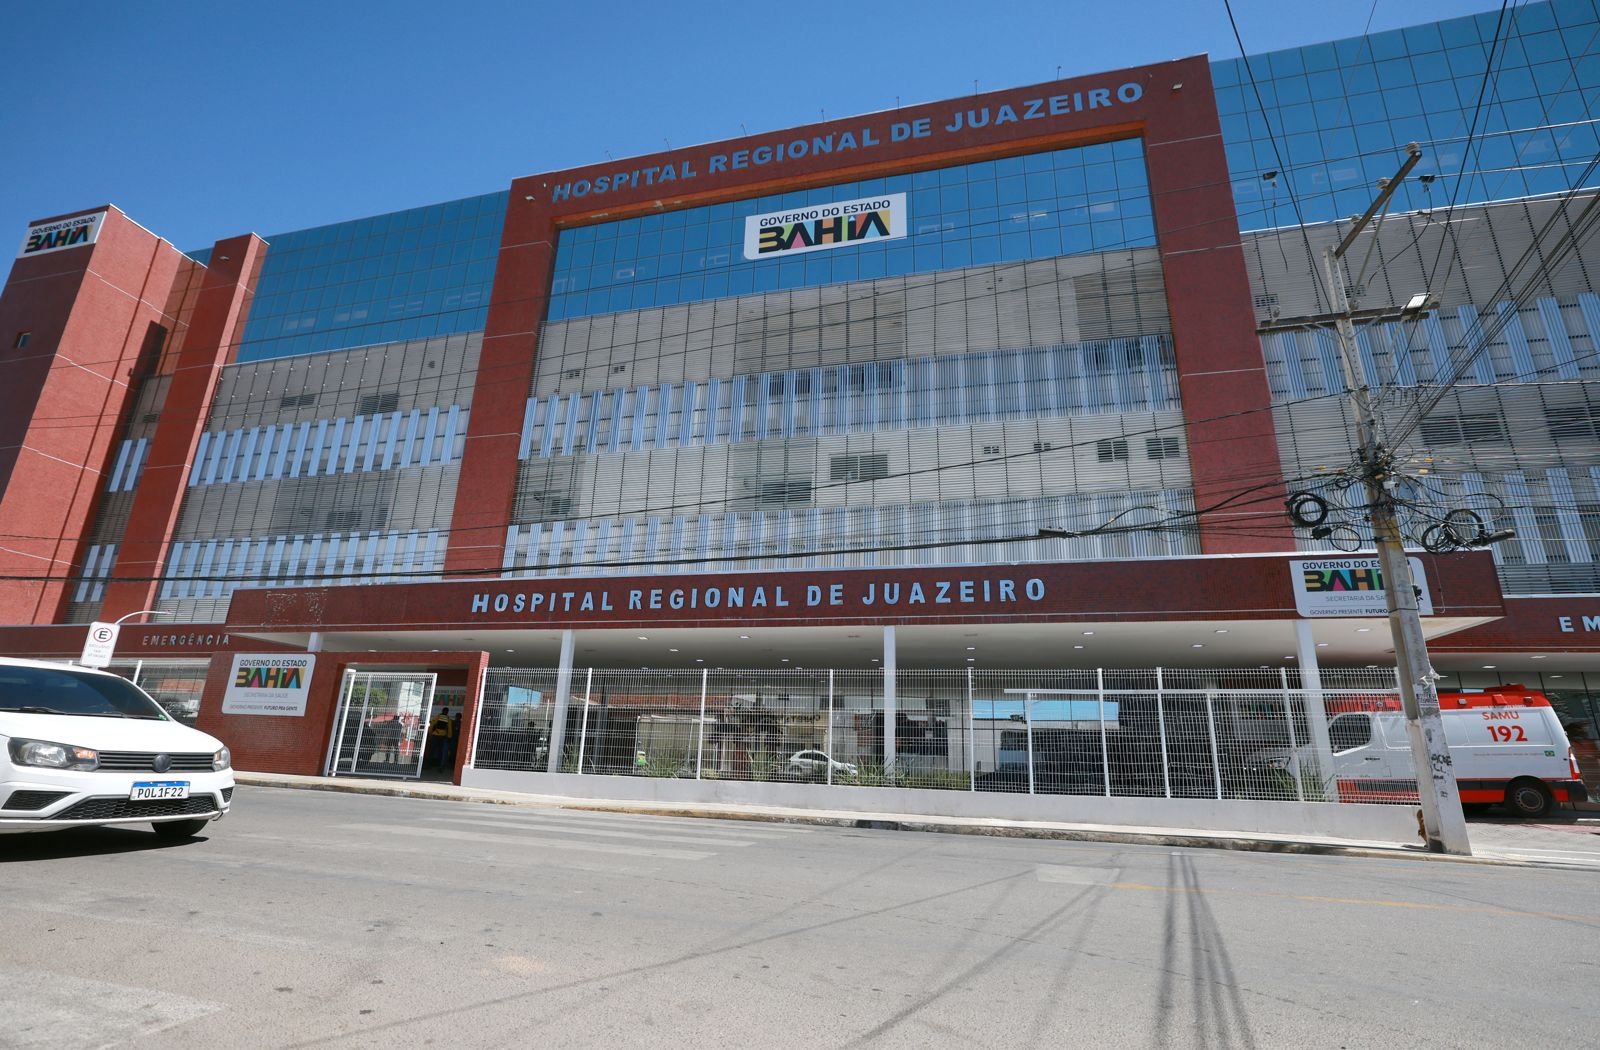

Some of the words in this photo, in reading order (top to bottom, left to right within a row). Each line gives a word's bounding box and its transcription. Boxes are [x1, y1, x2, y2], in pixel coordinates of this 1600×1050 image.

[552, 161, 697, 203] HOSPITAL
[709, 128, 880, 174] REGIONAL
[891, 118, 931, 143] DE
[945, 82, 1144, 133] JUAZEIRO
[760, 210, 818, 227] GOVERNO
[822, 207, 840, 218] DO
[843, 200, 890, 214] ESTADO
[24, 225, 91, 254] BAHIA
[758, 210, 890, 254] BAHIA
[1302, 560, 1351, 570] GOVERNO
[1354, 560, 1368, 568] DO
[1303, 569, 1385, 592] BAHI
[471, 591, 614, 613] HOSPITAL
[629, 586, 789, 610] REGIONAL
[807, 584, 844, 607] DE
[862, 578, 1045, 605] JUAZEIRO
[98, 630, 108, 639] E
[142, 633, 230, 646] EMERGÊNCIA
[240, 659, 270, 667] GOVERNO
[271, 659, 281, 667] DO
[282, 659, 308, 667] ESTADO
[235, 667, 304, 689] BAHIA
[1482, 711, 1519, 720] SAMU
[1487, 725, 1528, 742] 192
[138, 787, 184, 798] POL1F22
